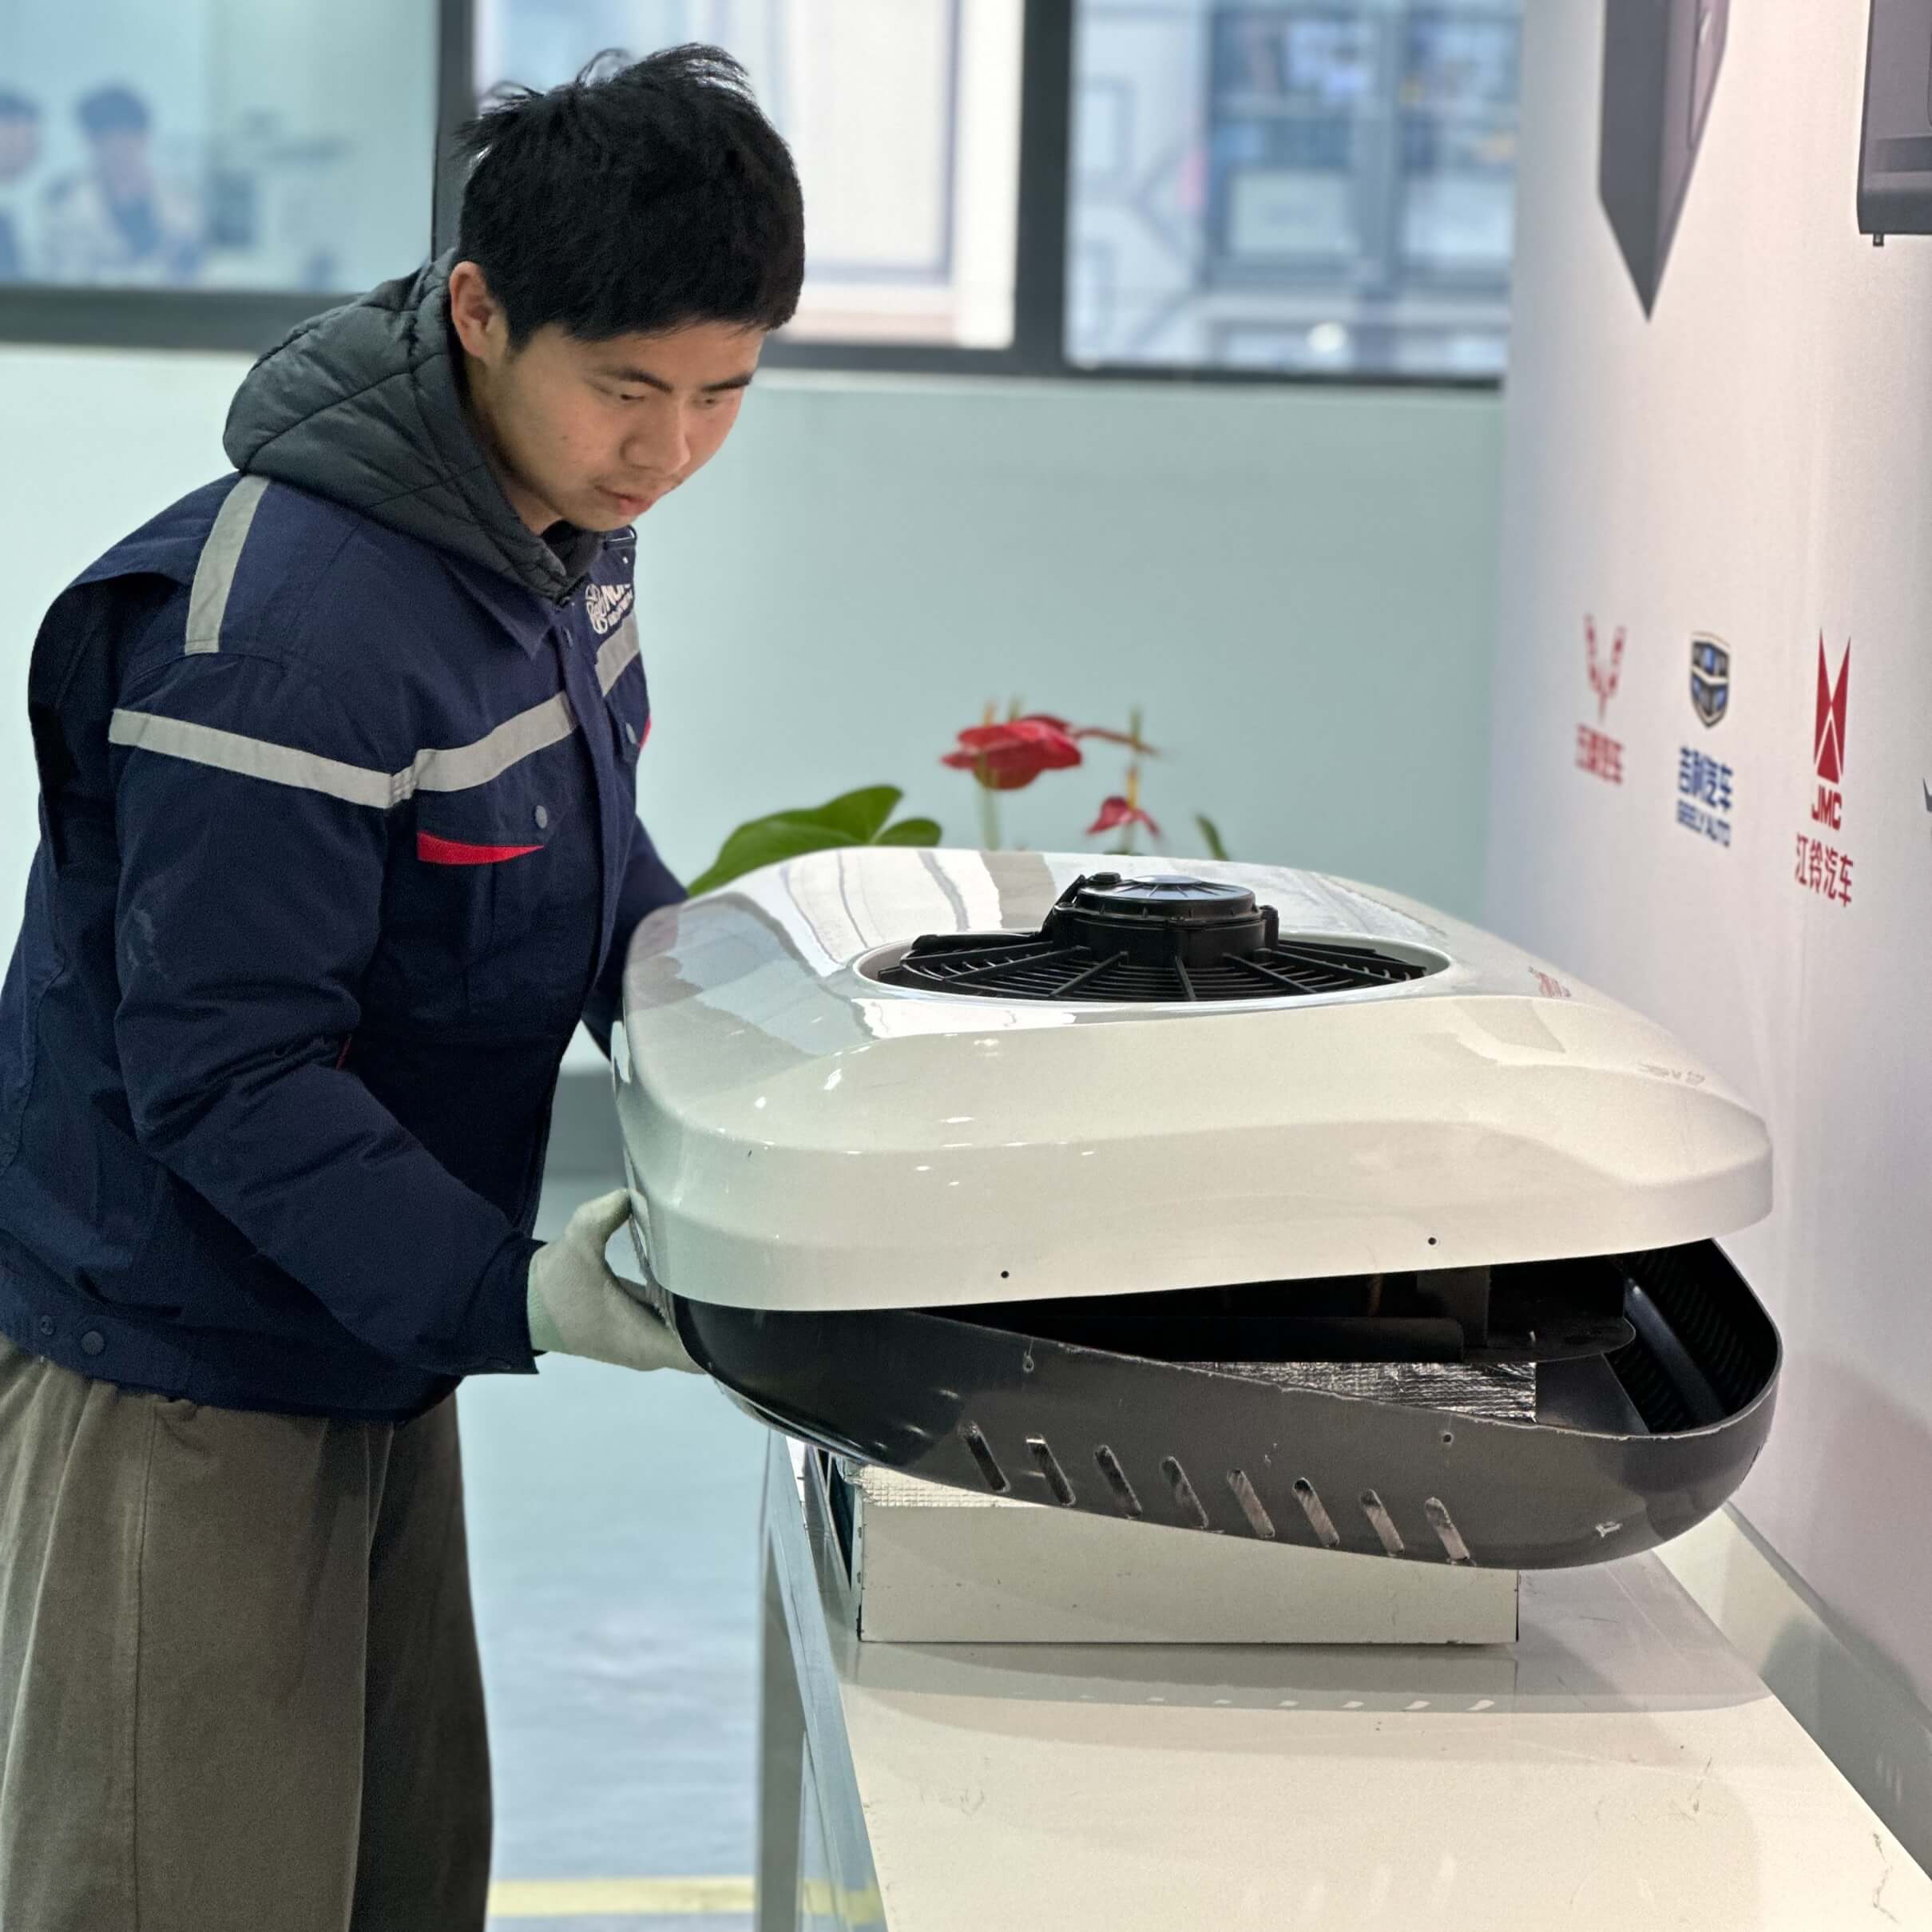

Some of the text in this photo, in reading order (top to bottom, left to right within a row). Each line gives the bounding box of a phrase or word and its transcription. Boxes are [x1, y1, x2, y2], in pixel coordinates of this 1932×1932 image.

[1811, 785, 1842, 831] JMC
[1795, 832, 1854, 907] 江铃汽车
